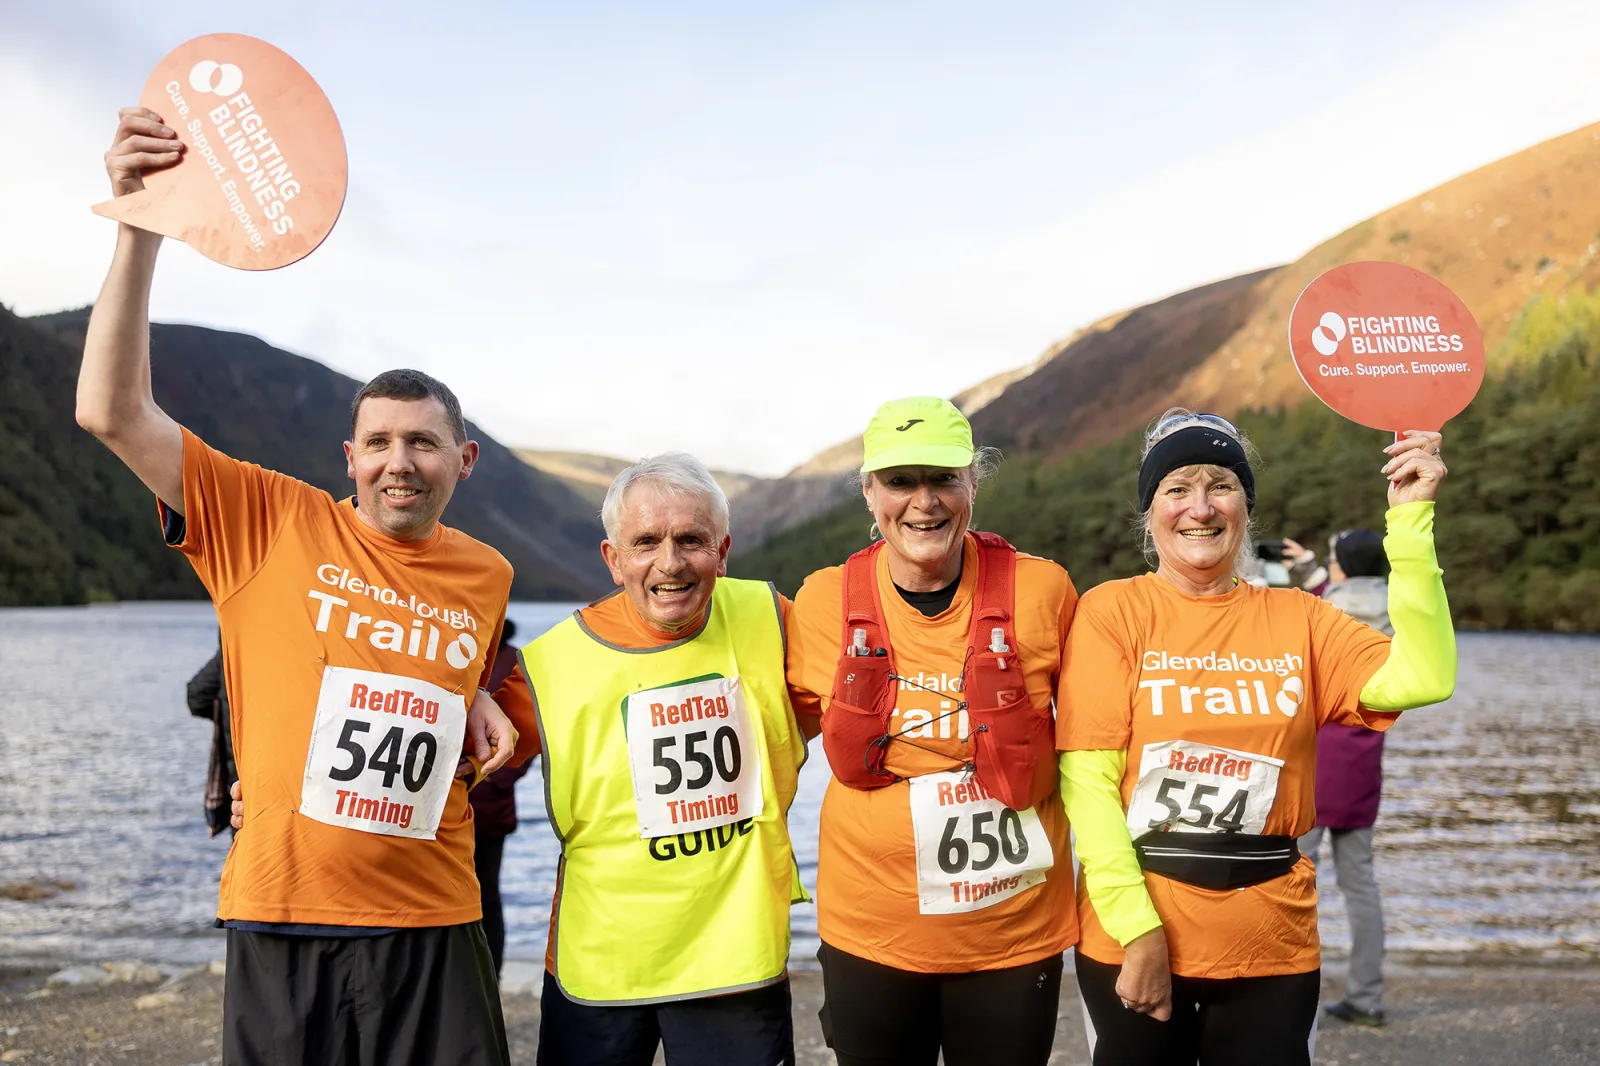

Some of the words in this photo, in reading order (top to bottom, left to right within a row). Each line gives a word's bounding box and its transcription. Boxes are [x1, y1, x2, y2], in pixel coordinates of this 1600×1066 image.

[165, 80, 190, 121] Cure.
[187, 117, 227, 182] Support.
[220, 178, 266, 253] Empower.
[228, 91, 301, 202] FIGHTING
[208, 103, 294, 236] BLINDNESS
[1347, 315, 1440, 335] FIGHTING
[1351, 334, 1464, 355] BLINDNESS
[1318, 363, 1354, 377] Cure.
[1356, 362, 1409, 378] Support.
[1410, 361, 1471, 376] Empower.
[308, 589, 441, 662] Trail
[1142, 650, 1303, 677] Glendalough
[349, 683, 440, 725] RedTag
[650, 695, 729, 728] RedTag
[1139, 678, 1271, 716] Trail
[328, 718, 438, 794] 540
[653, 725, 742, 795] 550
[1167, 749, 1252, 782] RedTag
[335, 789, 414, 829] Timing
[666, 792, 739, 825] Timing
[1147, 777, 1249, 834] 554
[648, 815, 754, 862] GUIDE
[937, 807, 1029, 875] 650
[949, 874, 1023, 903] Timing
